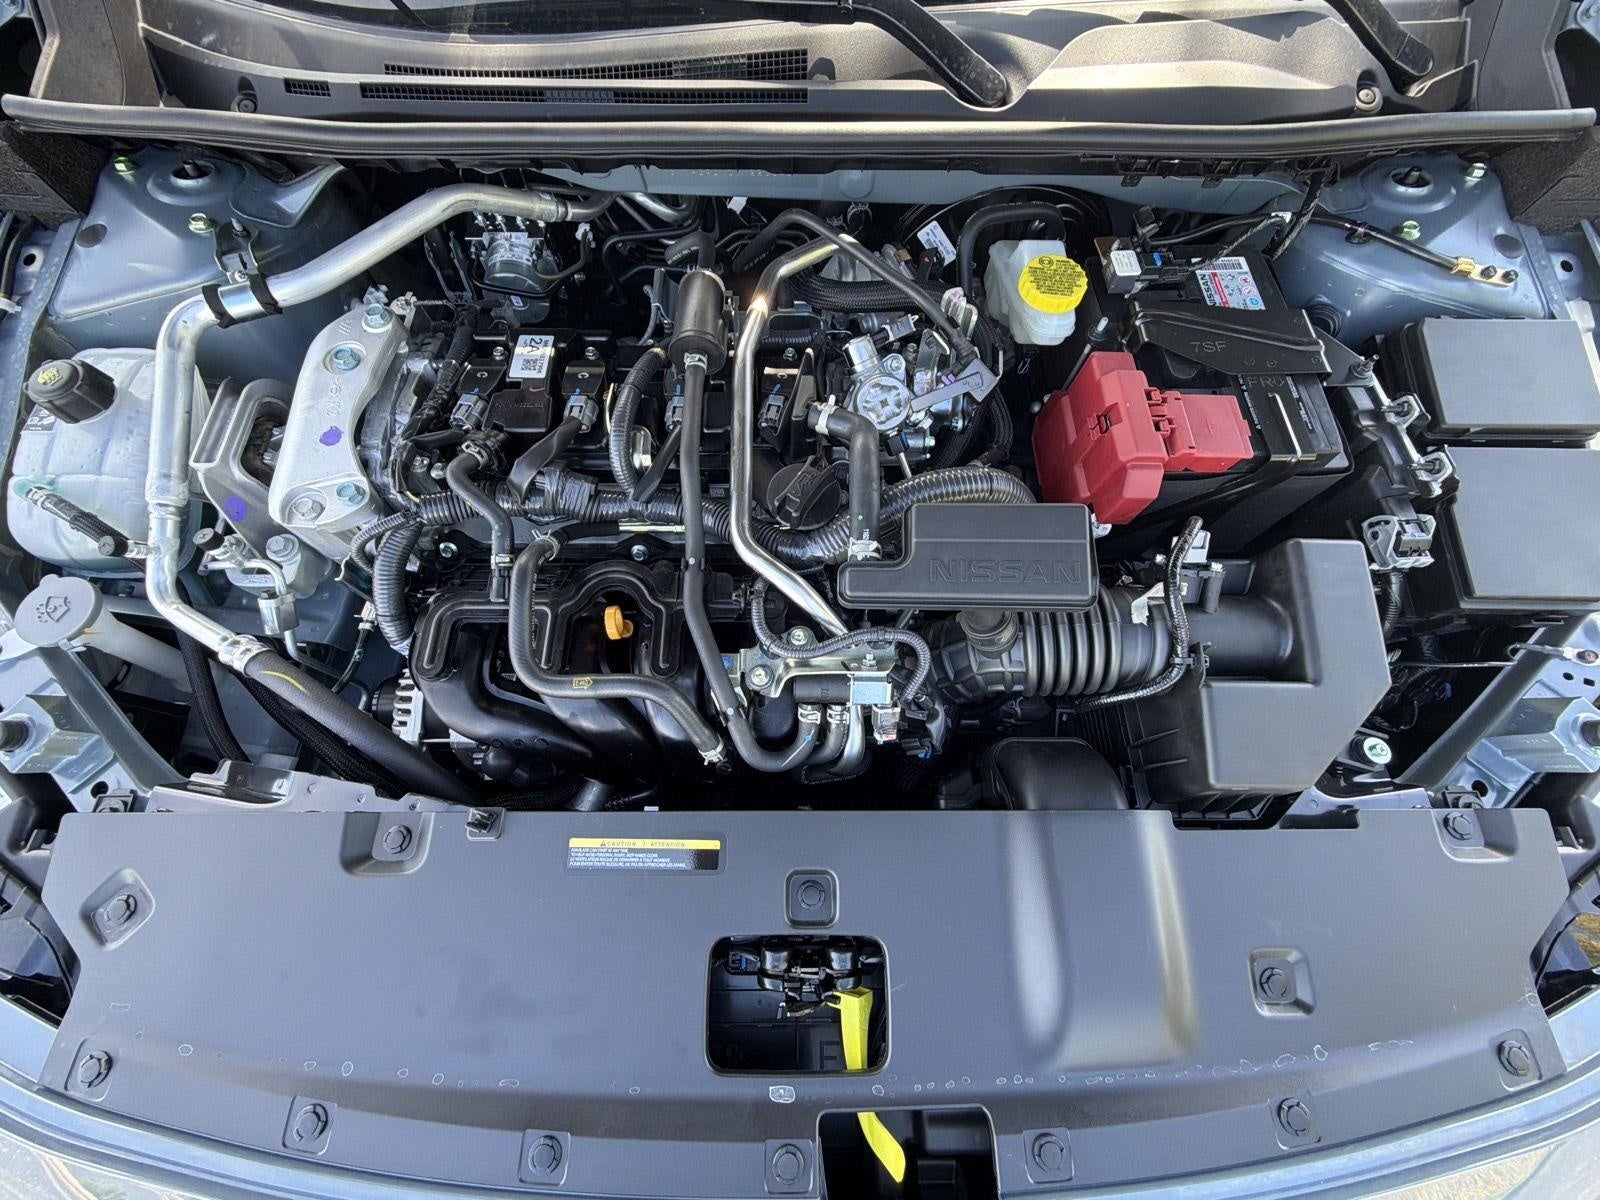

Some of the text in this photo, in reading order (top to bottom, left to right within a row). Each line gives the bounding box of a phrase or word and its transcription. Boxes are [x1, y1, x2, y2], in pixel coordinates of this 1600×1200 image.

[1199, 273, 1217, 306] NISSAN
[527, 337, 543, 354] 2A
[928, 558, 1082, 585] NISSAN
